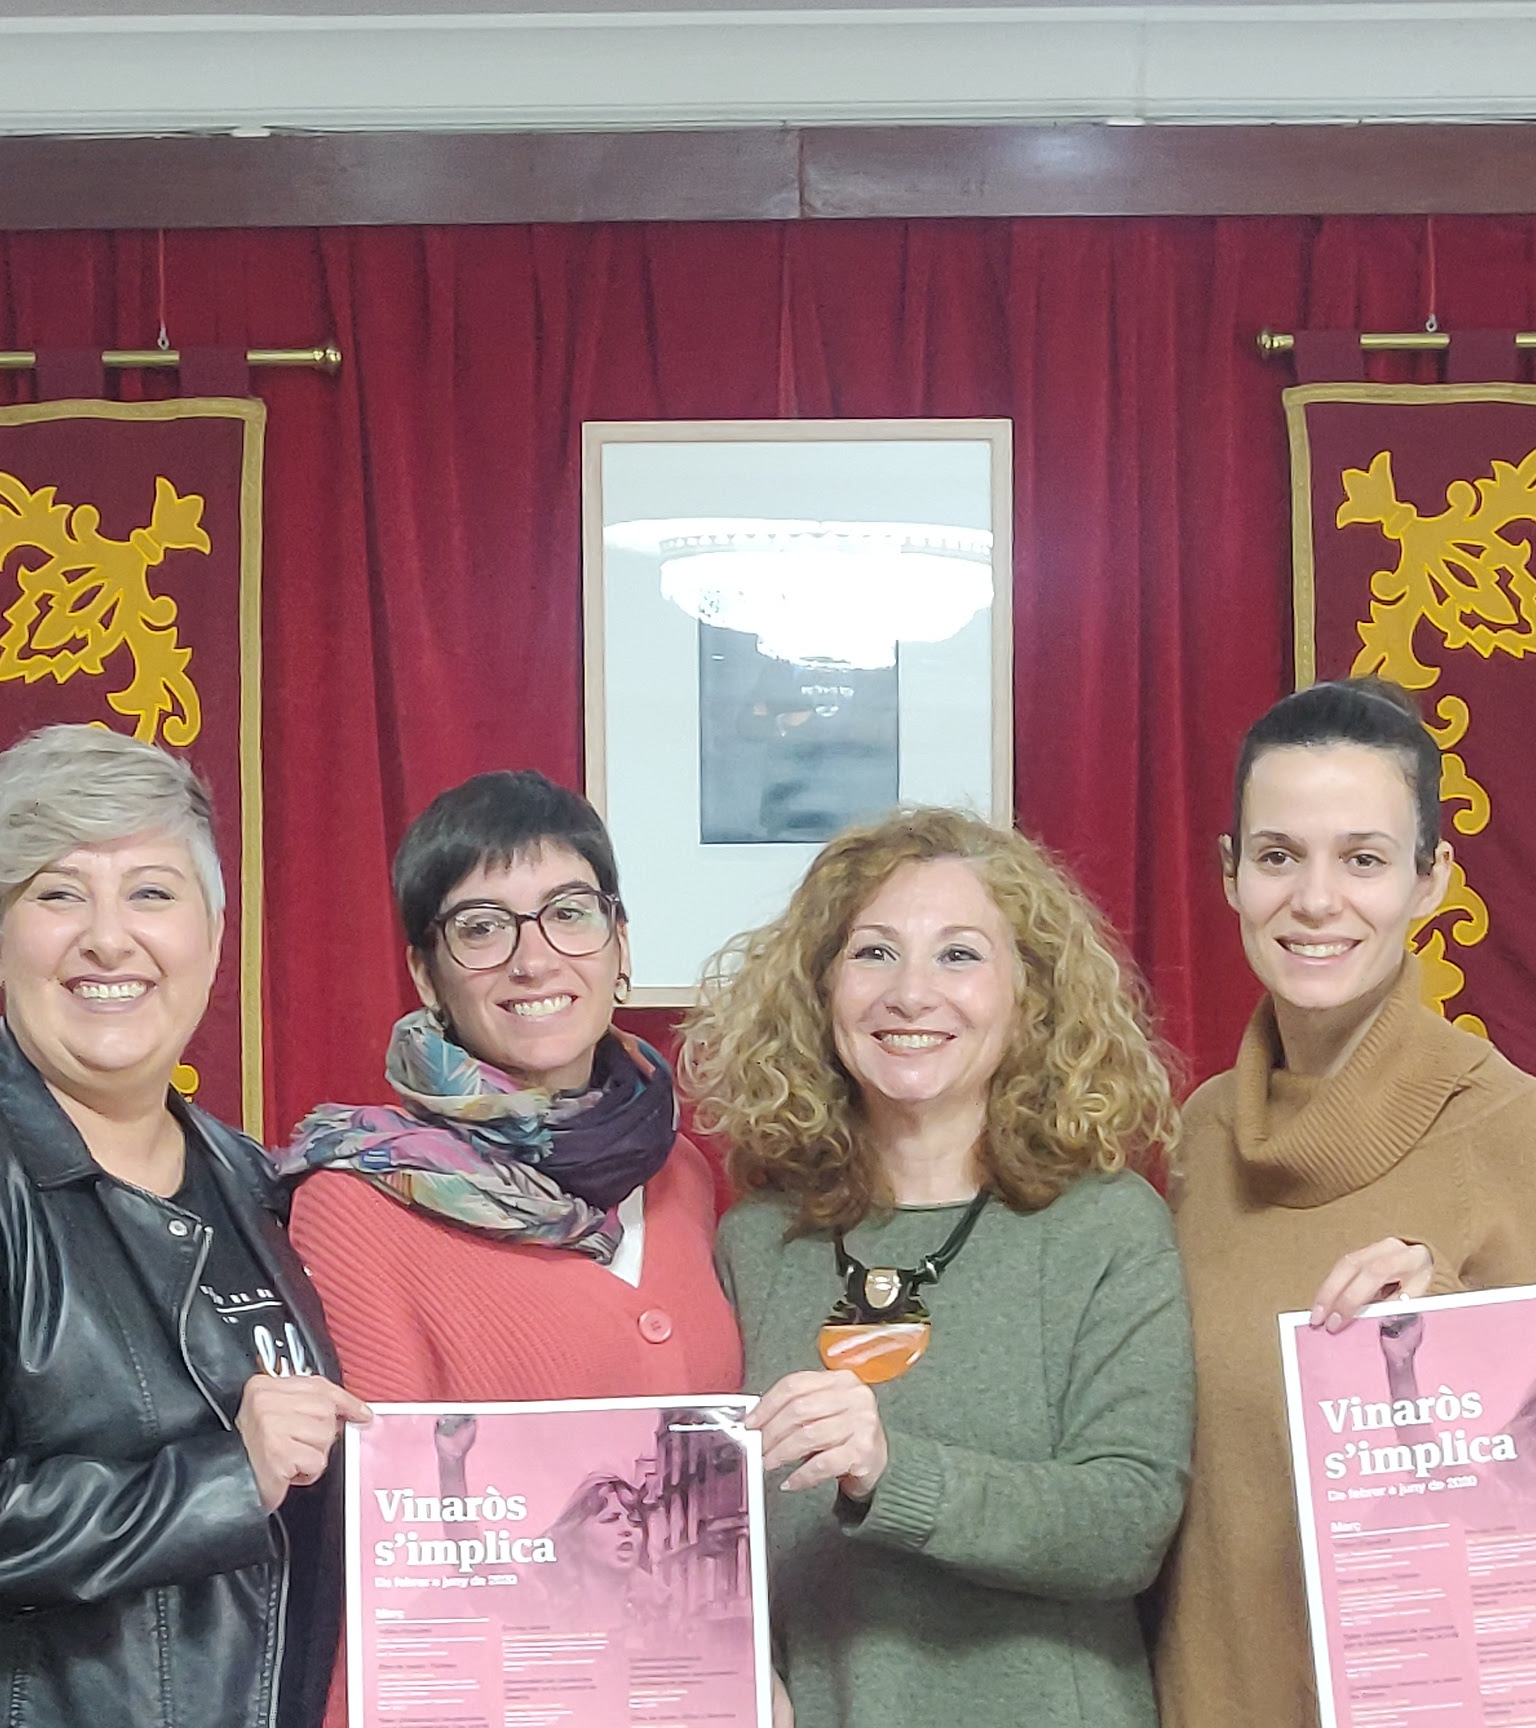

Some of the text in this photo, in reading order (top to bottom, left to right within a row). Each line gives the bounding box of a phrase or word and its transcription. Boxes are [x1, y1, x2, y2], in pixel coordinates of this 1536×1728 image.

[1319, 1385, 1481, 1432] Vinaròs
[1324, 1429, 1517, 1478] s'implica
[374, 1486, 526, 1522] Vinaròs
[374, 1530, 556, 1573] s'implica
